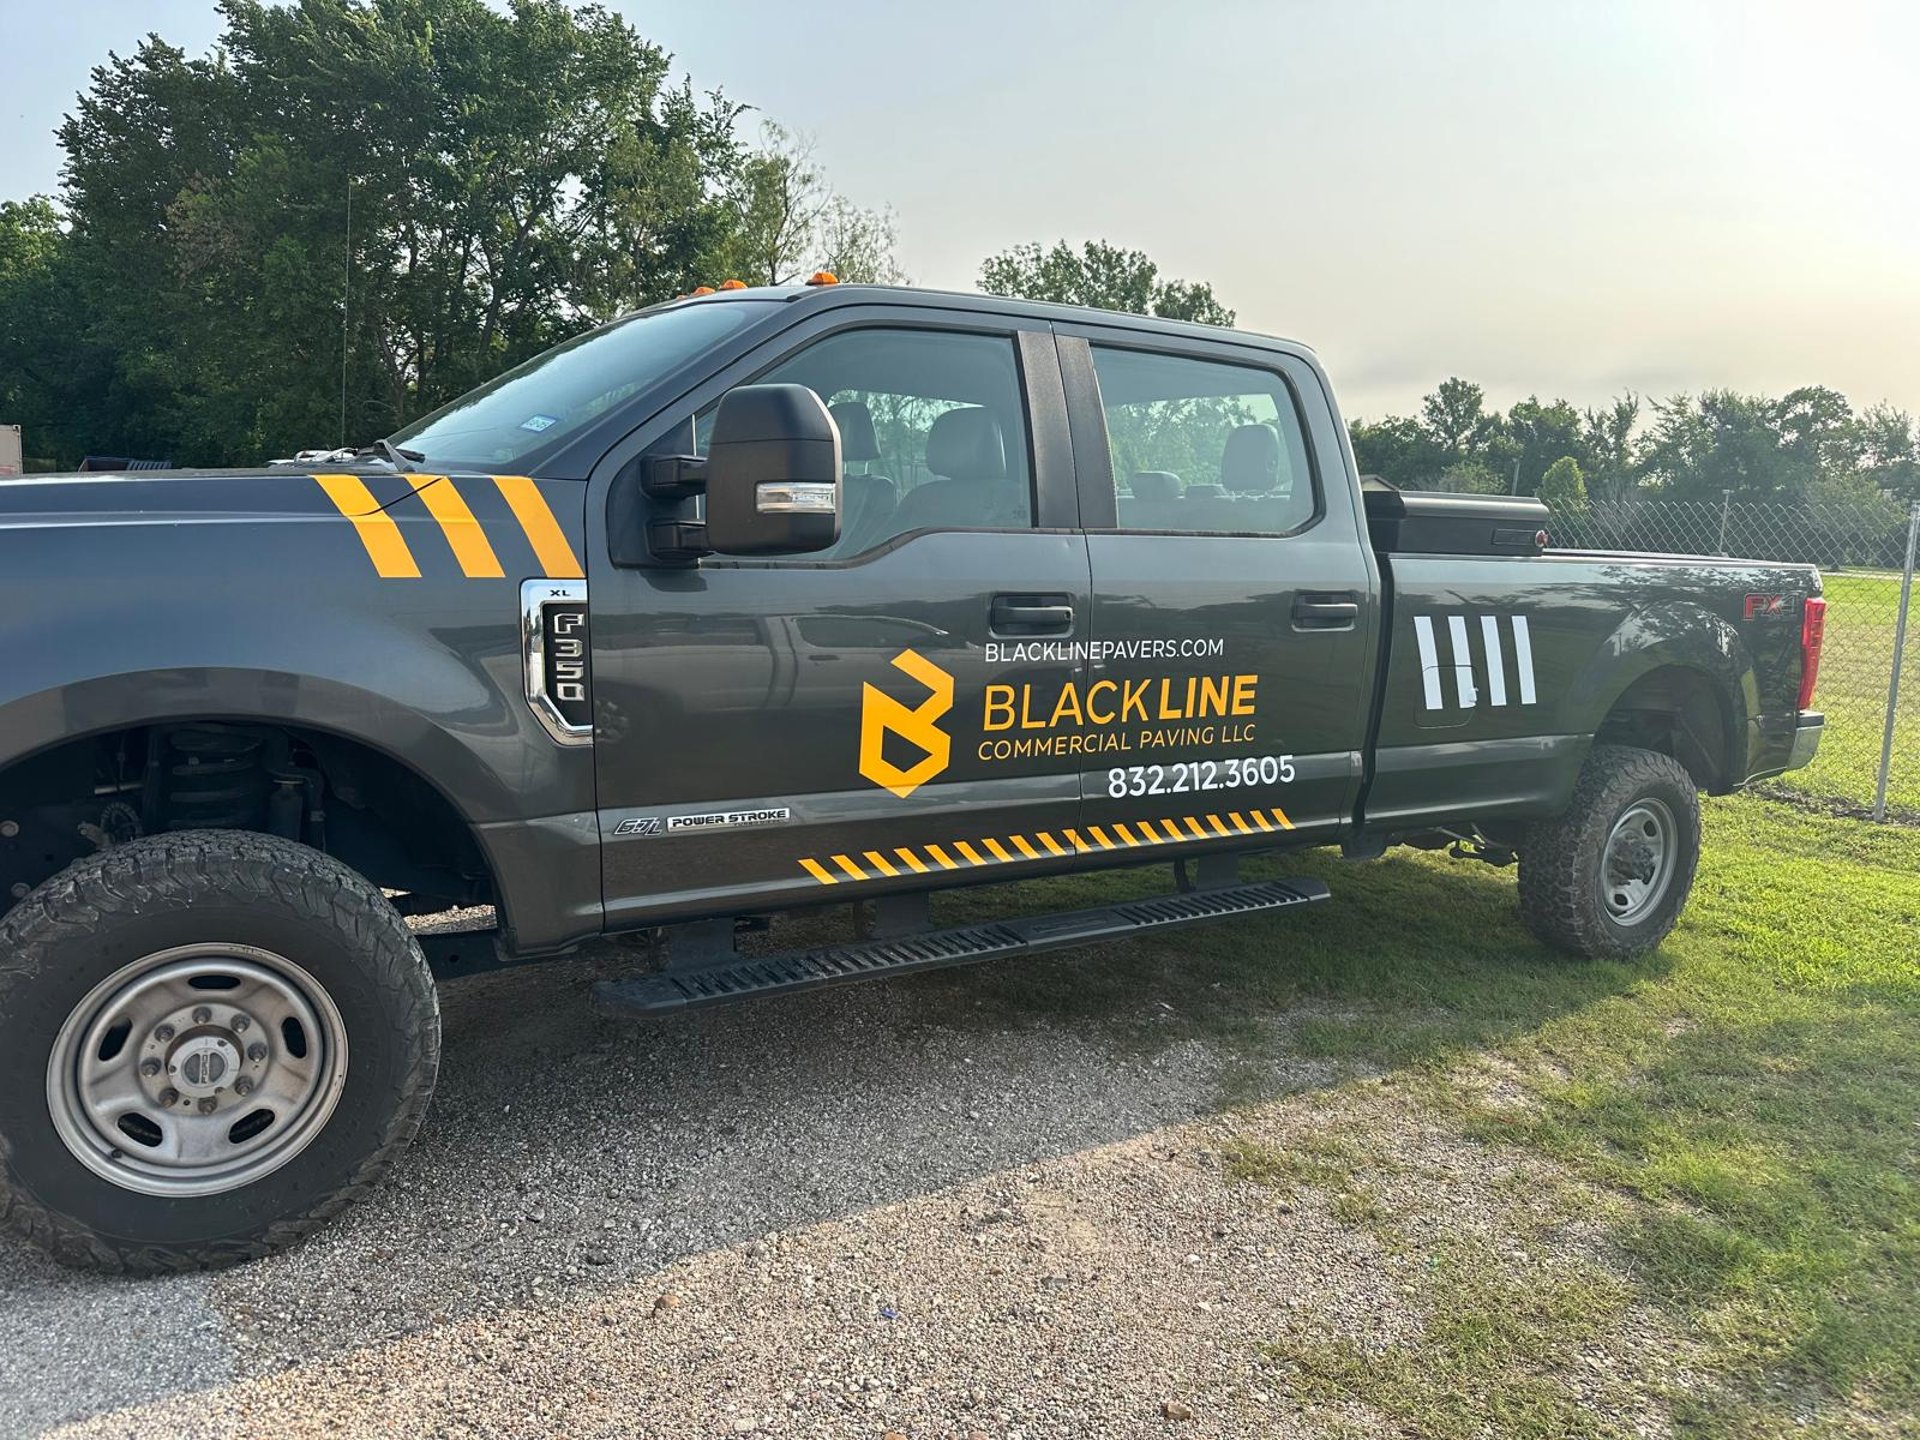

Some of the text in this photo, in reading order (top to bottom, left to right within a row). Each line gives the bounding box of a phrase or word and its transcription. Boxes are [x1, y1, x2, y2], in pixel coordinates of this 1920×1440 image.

[550, 589, 570, 597] XL
[985, 638, 1224, 663] BLACKLINEPAVERS.COM
[978, 723, 1256, 761] COMMERCIAL PAVING LLC
[1108, 754, 1296, 799] 832.212.3605
[672, 815, 725, 828] POWER
[728, 810, 787, 823] STROKE
